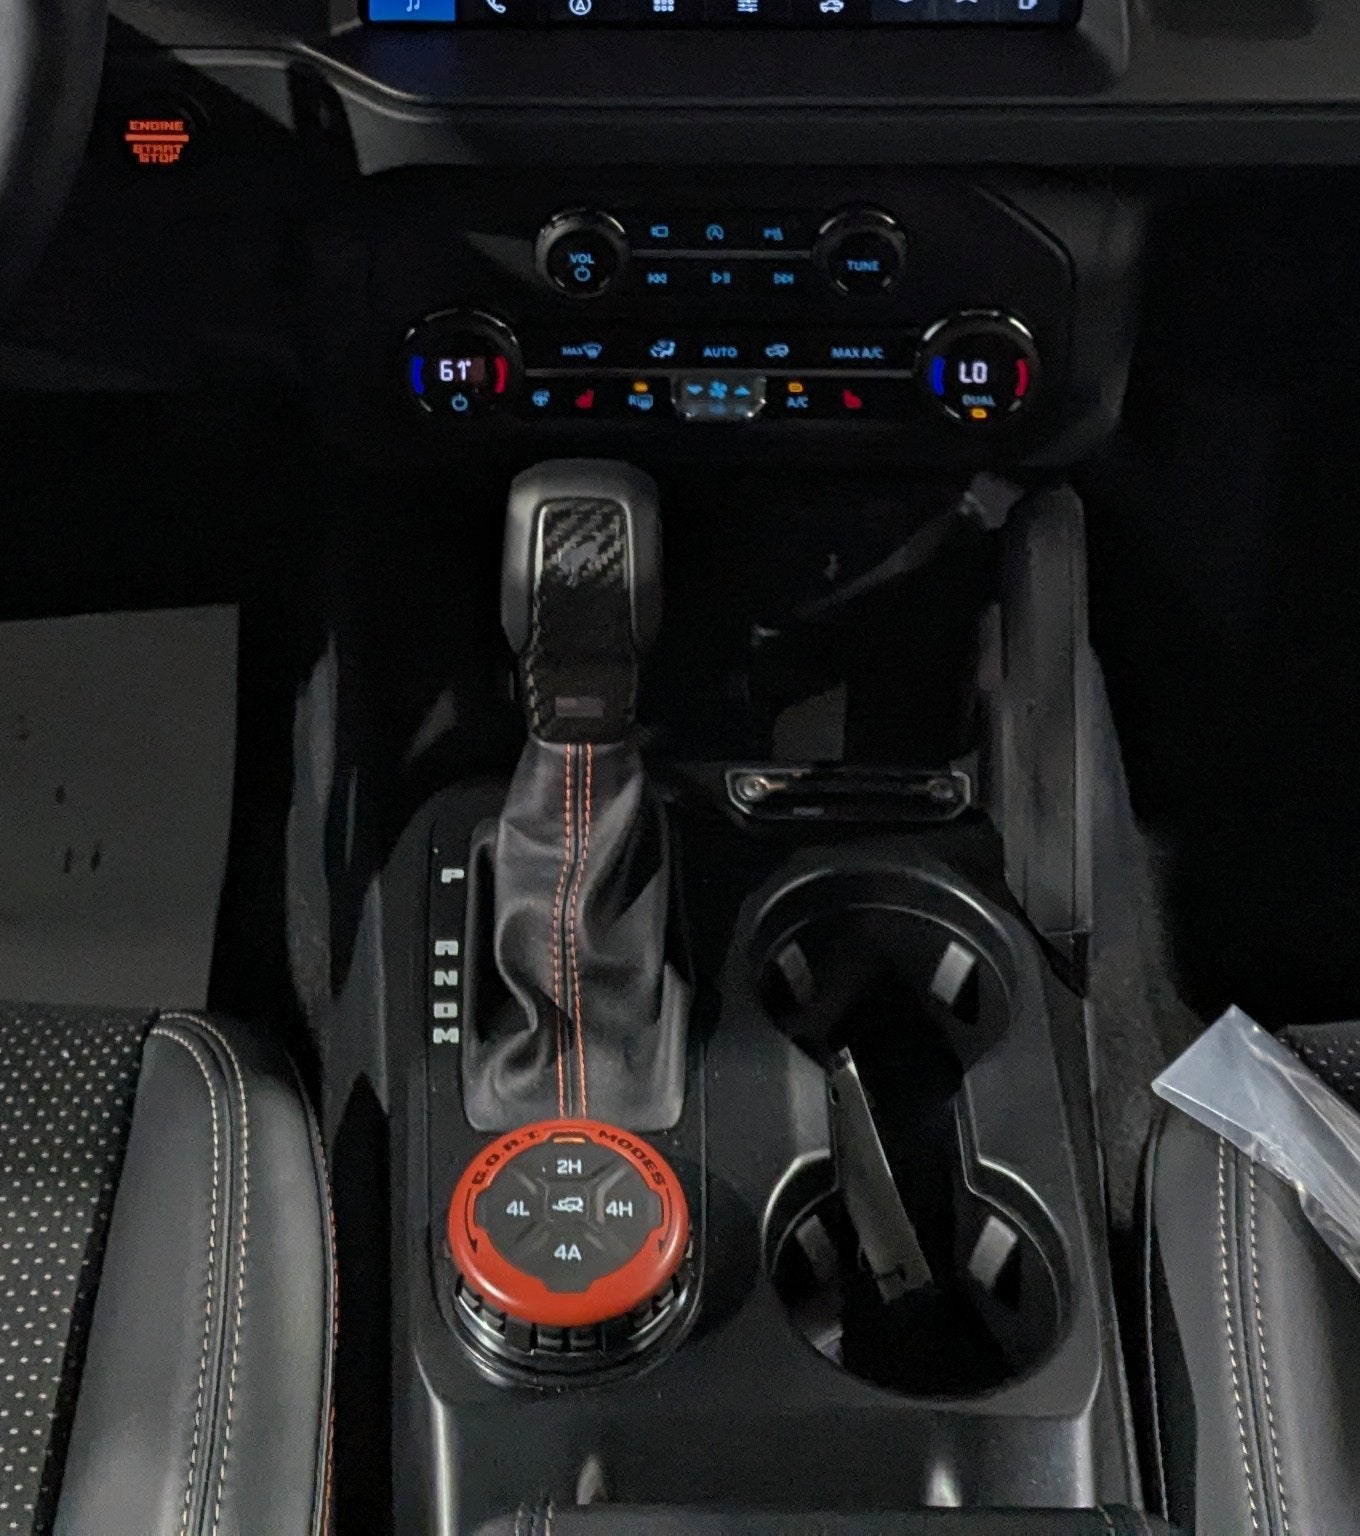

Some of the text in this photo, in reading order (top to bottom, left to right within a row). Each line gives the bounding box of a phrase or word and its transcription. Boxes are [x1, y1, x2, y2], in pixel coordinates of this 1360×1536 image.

[129, 120, 183, 131] ENGINE
[139, 153, 180, 163] STOP
[569, 253, 594, 264] VOL
[846, 260, 880, 272] TUNE
[562, 346, 583, 356] MAX
[702, 347, 737, 357] AUTO
[831, 347, 885, 359] MAX A/C
[958, 361, 988, 384] LO
[787, 396, 808, 408] A/C
[961, 394, 996, 406] DUAL
[441, 868, 465, 884] P
[434, 939, 459, 955] R
[434, 970, 458, 986] N
[433, 1002, 458, 1019] D
[433, 1027, 459, 1043] M
[597, 1129, 666, 1186] MODES
[556, 1159, 582, 1175] 2H
[506, 1200, 530, 1217] 4L
[605, 1200, 633, 1217] 4H
[554, 1244, 582, 1261] 4A
